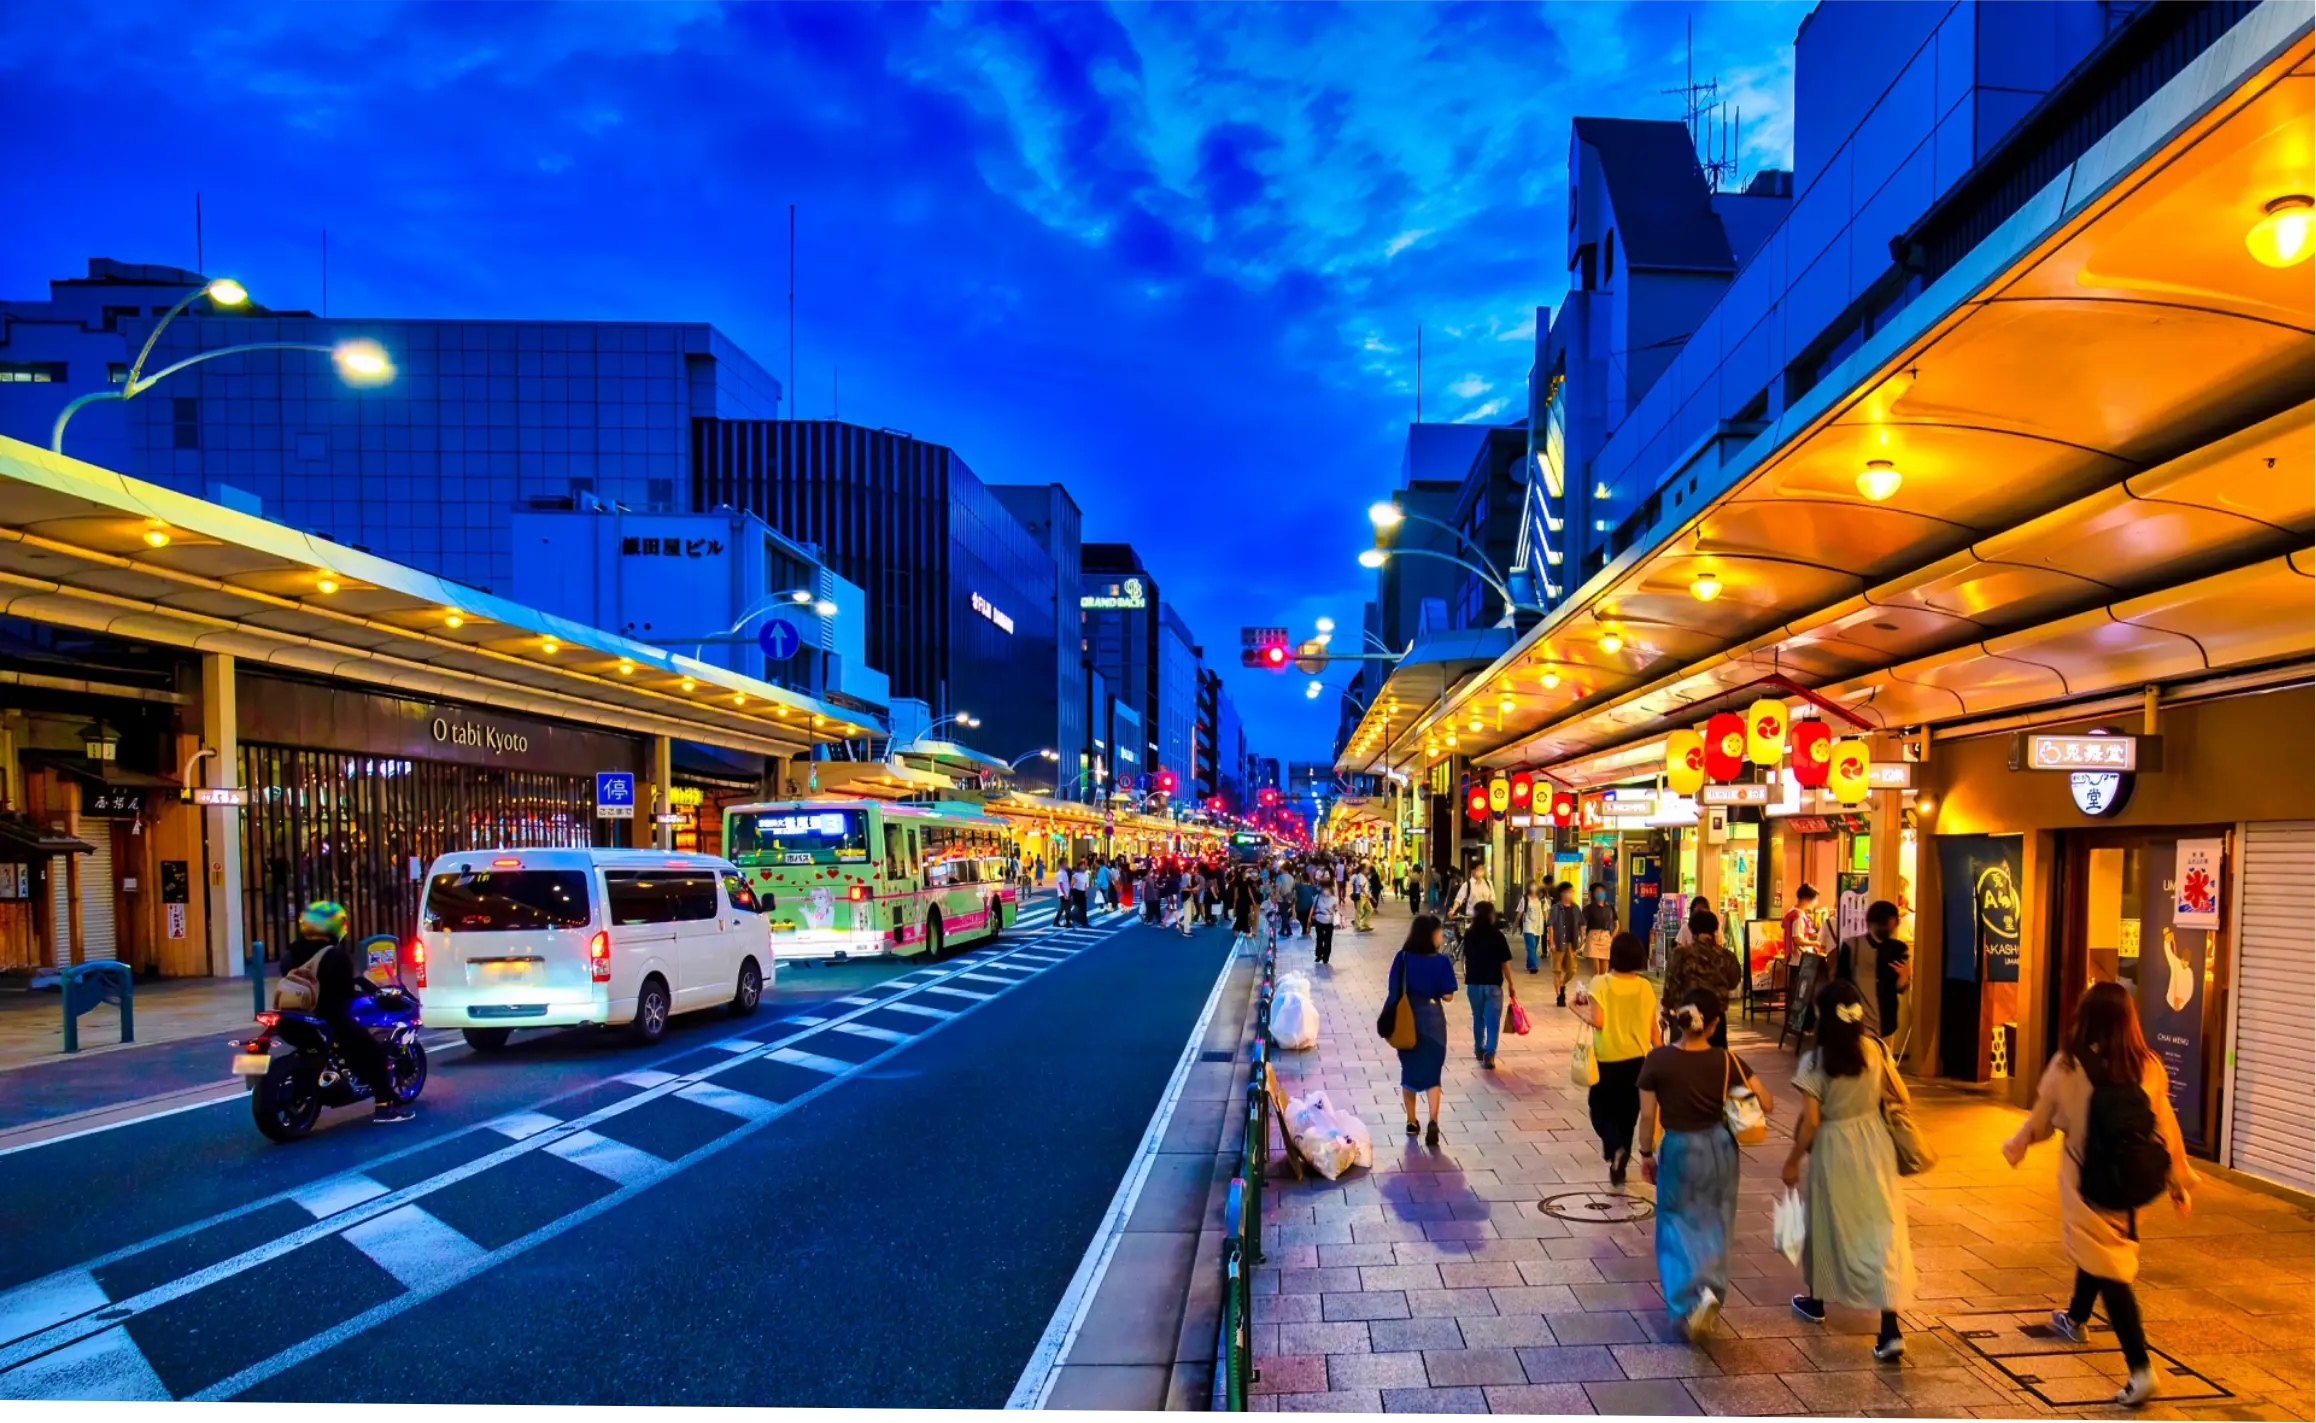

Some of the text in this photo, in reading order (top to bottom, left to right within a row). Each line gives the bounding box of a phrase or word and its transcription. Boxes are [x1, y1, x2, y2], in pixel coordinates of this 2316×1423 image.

[1080, 596, 1116, 608] GRAND
[433, 717, 528, 755] O tabi Kyoto
[603, 779, 628, 800] 停
[2086, 787, 2102, 811] 堂
[1985, 943, 2020, 956] AKASH
